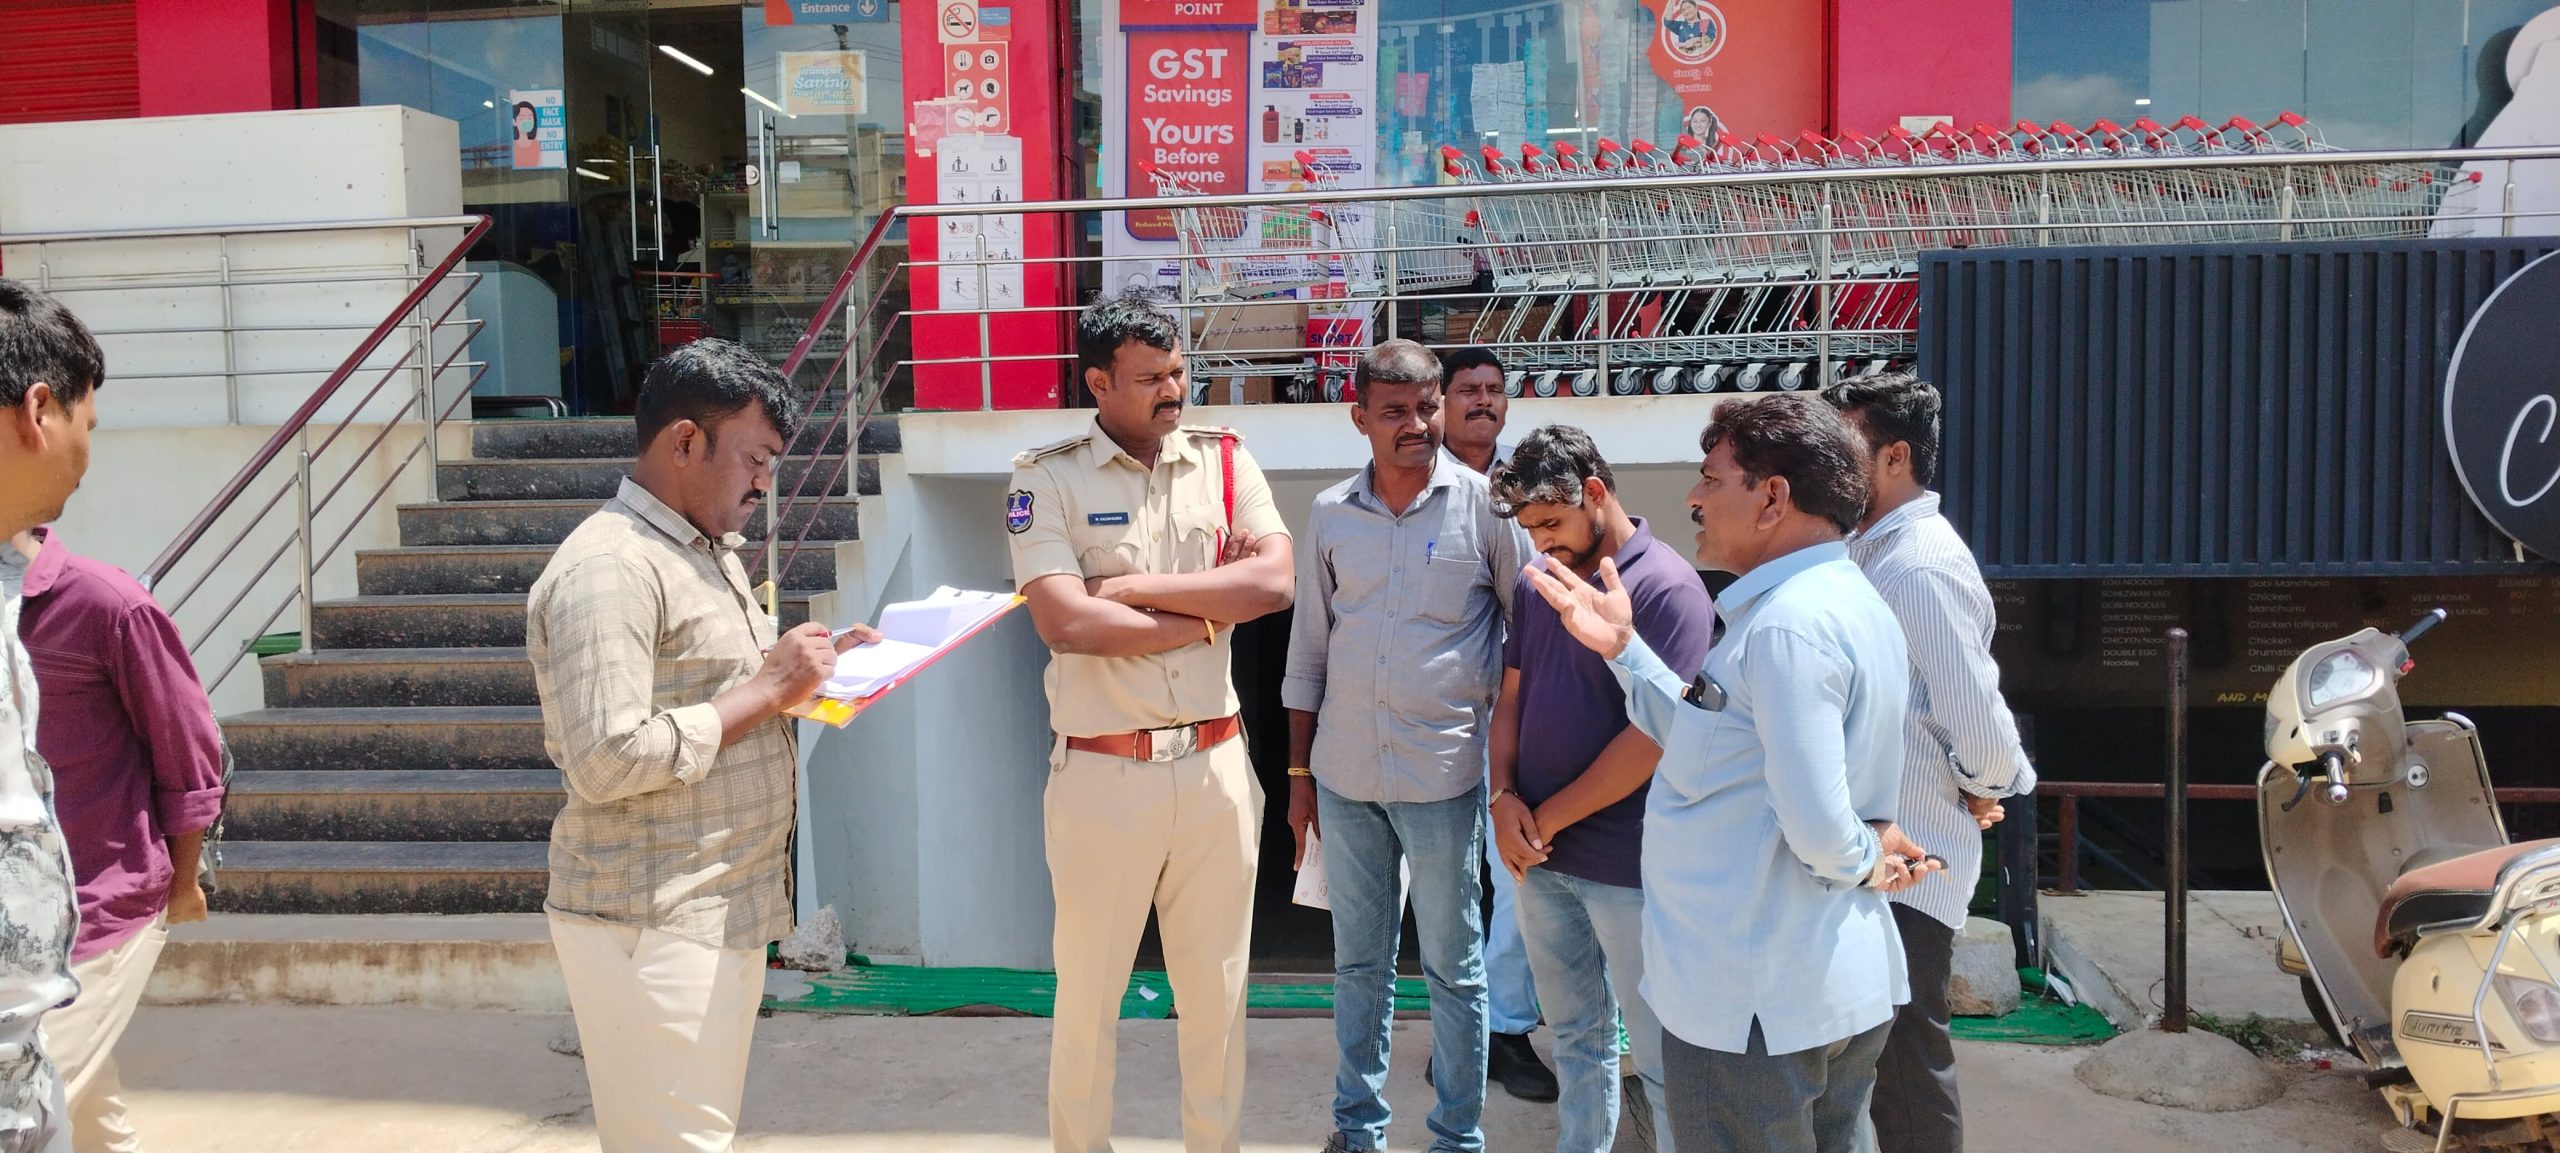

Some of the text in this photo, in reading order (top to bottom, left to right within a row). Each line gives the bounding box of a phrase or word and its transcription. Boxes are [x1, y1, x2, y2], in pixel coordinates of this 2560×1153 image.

[801, 3, 850, 13] Entrance
[1175, 3, 1224, 15] POINT
[1149, 48, 1228, 79] GST
[1143, 83, 1232, 107] Savings
[545, 96, 556, 104] NO
[541, 117, 561, 126] MASK
[1142, 117, 1234, 144] Yours
[1154, 147, 1219, 164] Before
[2248, 593, 2292, 602] Chicken
[2436, 594, 2470, 602] MOMO
[1999, 623, 2023, 632] Rice
[2247, 620, 2292, 629] Chicken
[2248, 636, 2292, 645] Chicken
[2103, 649, 2137, 657] DOUBLE
[2103, 660, 2140, 668] Noodles
[2250, 663, 2276, 673] Chilli
[2217, 692, 2248, 703] AND
